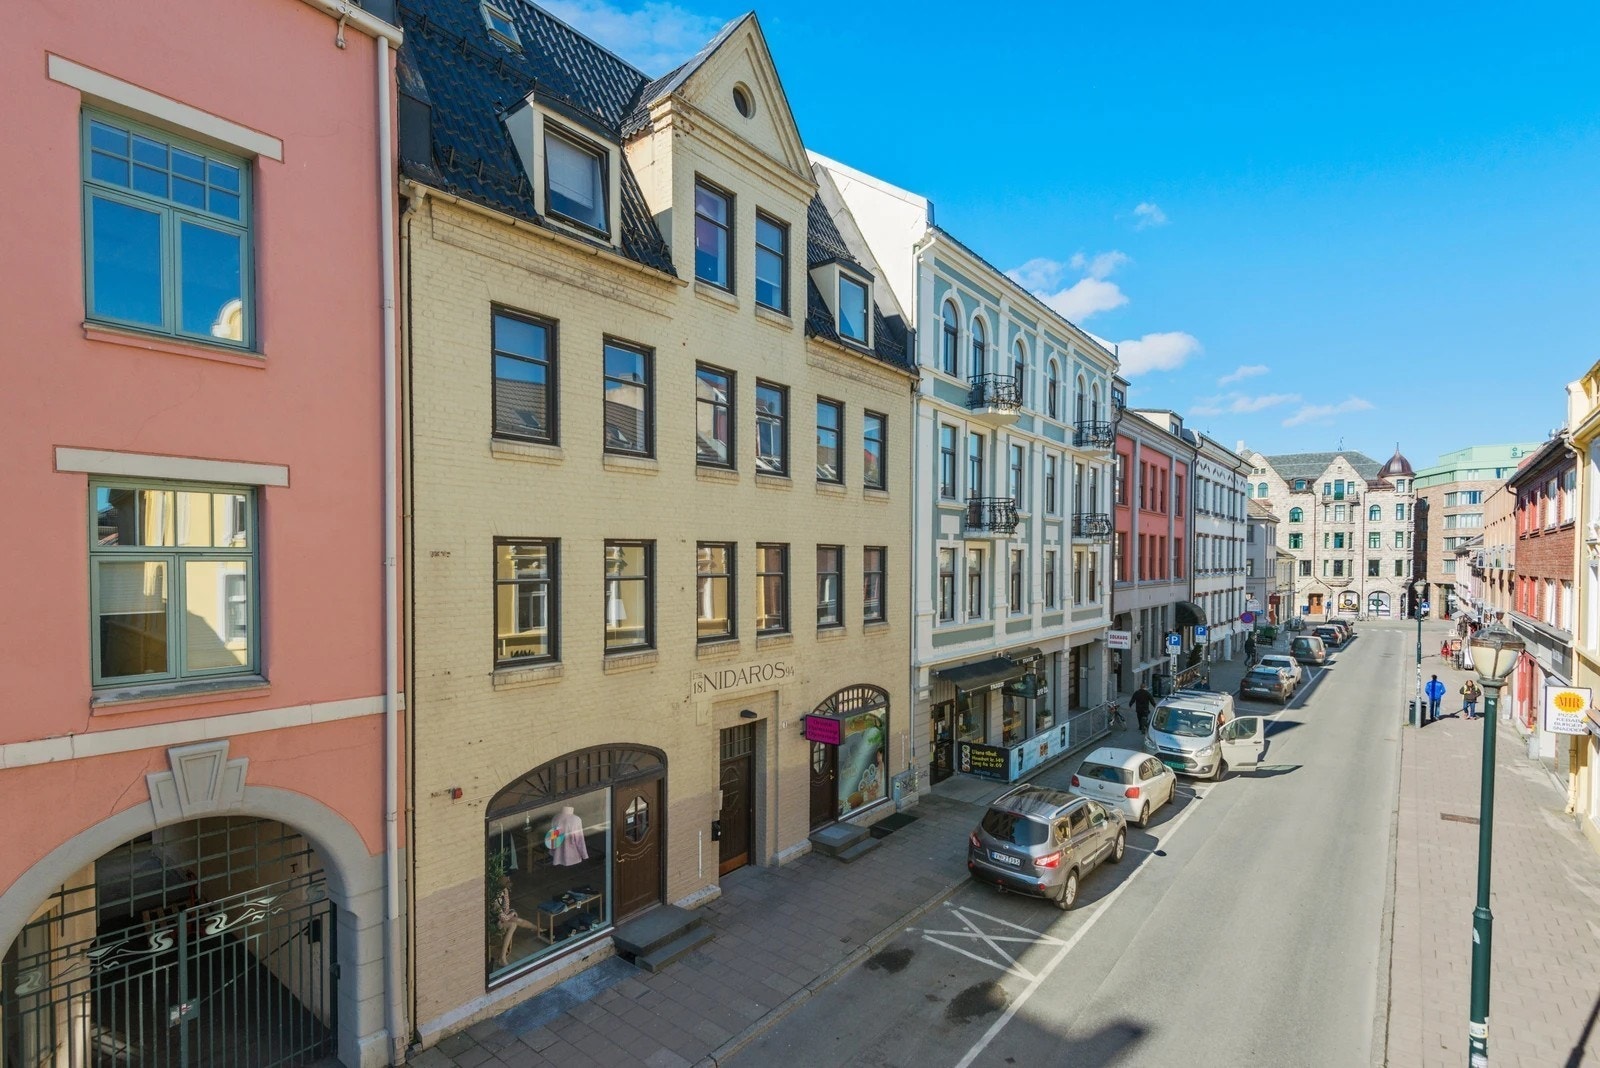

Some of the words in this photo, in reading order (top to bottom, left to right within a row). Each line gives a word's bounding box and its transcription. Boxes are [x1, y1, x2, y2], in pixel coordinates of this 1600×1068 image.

[1171, 636, 1178, 644] P
[693, 681, 703, 694] 18
[703, 662, 785, 692] NIDAROS
[1559, 697, 1580, 708] MIR
